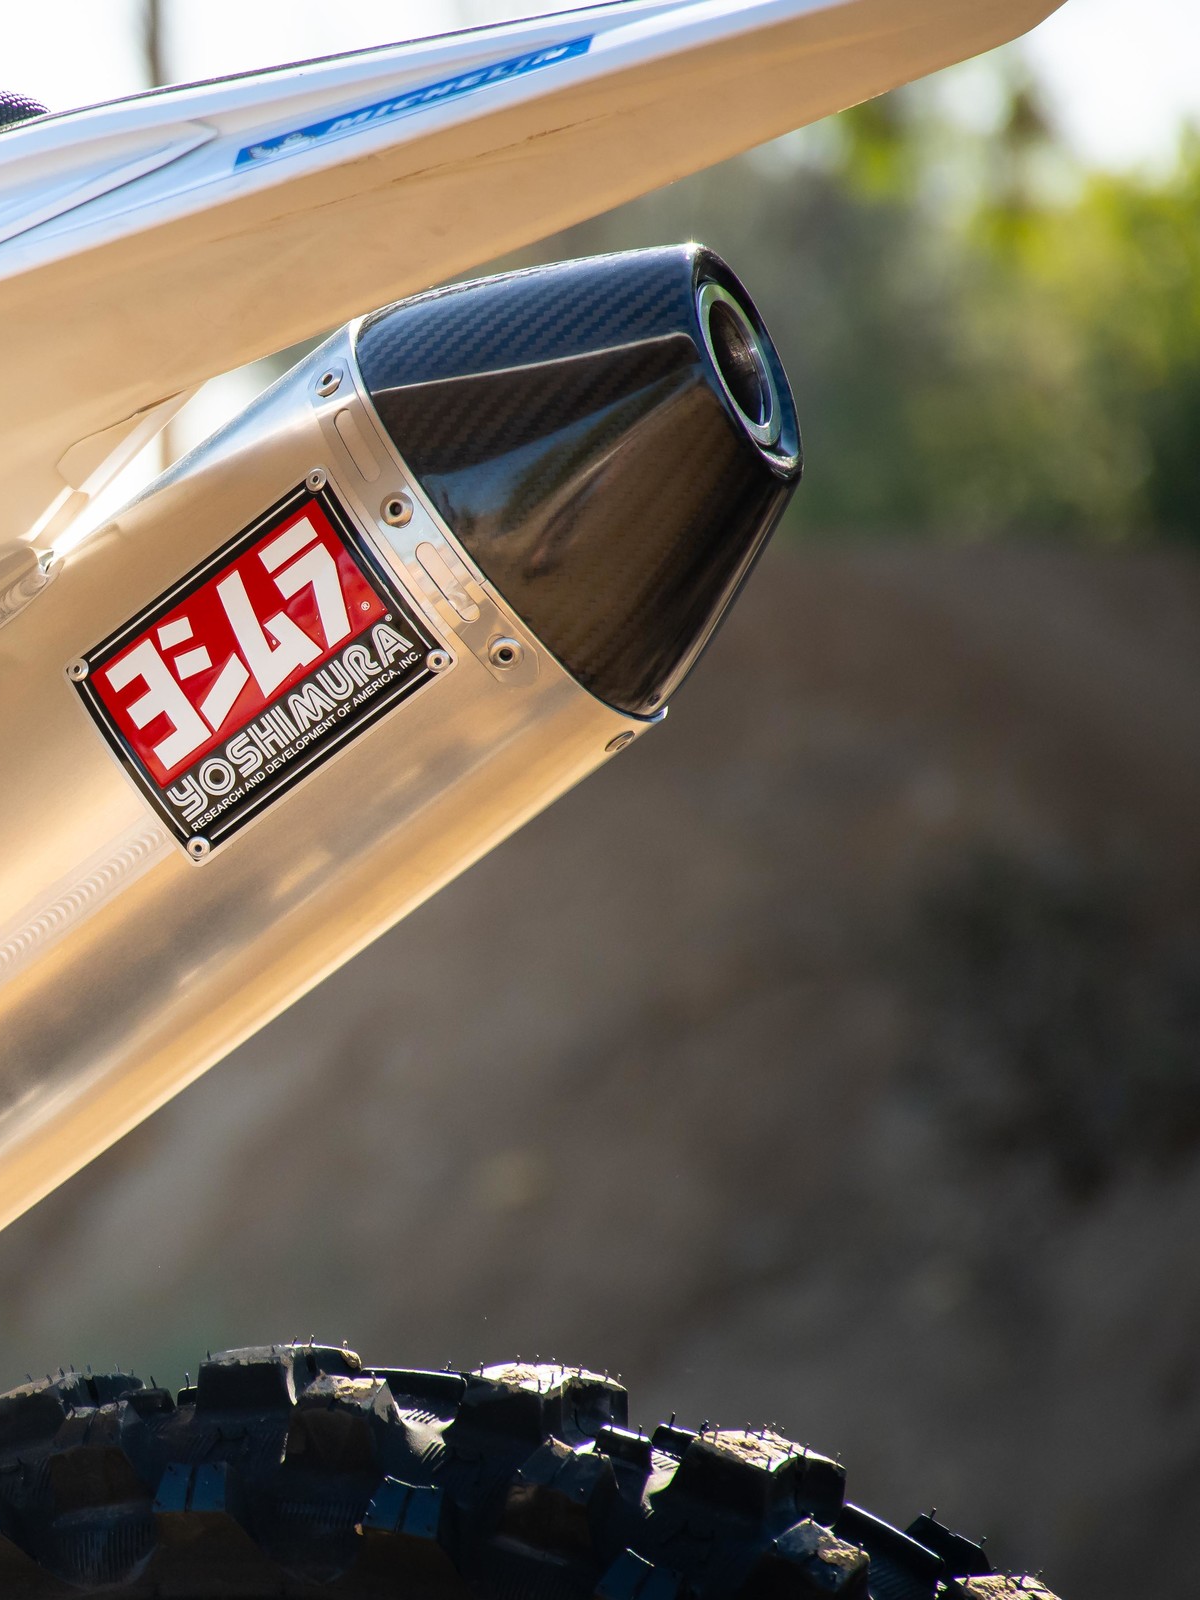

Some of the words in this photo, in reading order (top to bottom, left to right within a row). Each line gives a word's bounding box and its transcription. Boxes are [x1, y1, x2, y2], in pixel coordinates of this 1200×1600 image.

[328, 46, 569, 132] MICHELIN
[105, 517, 353, 770] ヨシムラ
[166, 623, 414, 822] YOSHIMURA
[191, 787, 245, 832] RESEARCH
[244, 771, 266, 792] AND
[265, 714, 336, 774] DEVELOPMENT
[337, 702, 351, 717] OF
[353, 669, 401, 707] AMERICA,
[398, 652, 422, 669] INC.
